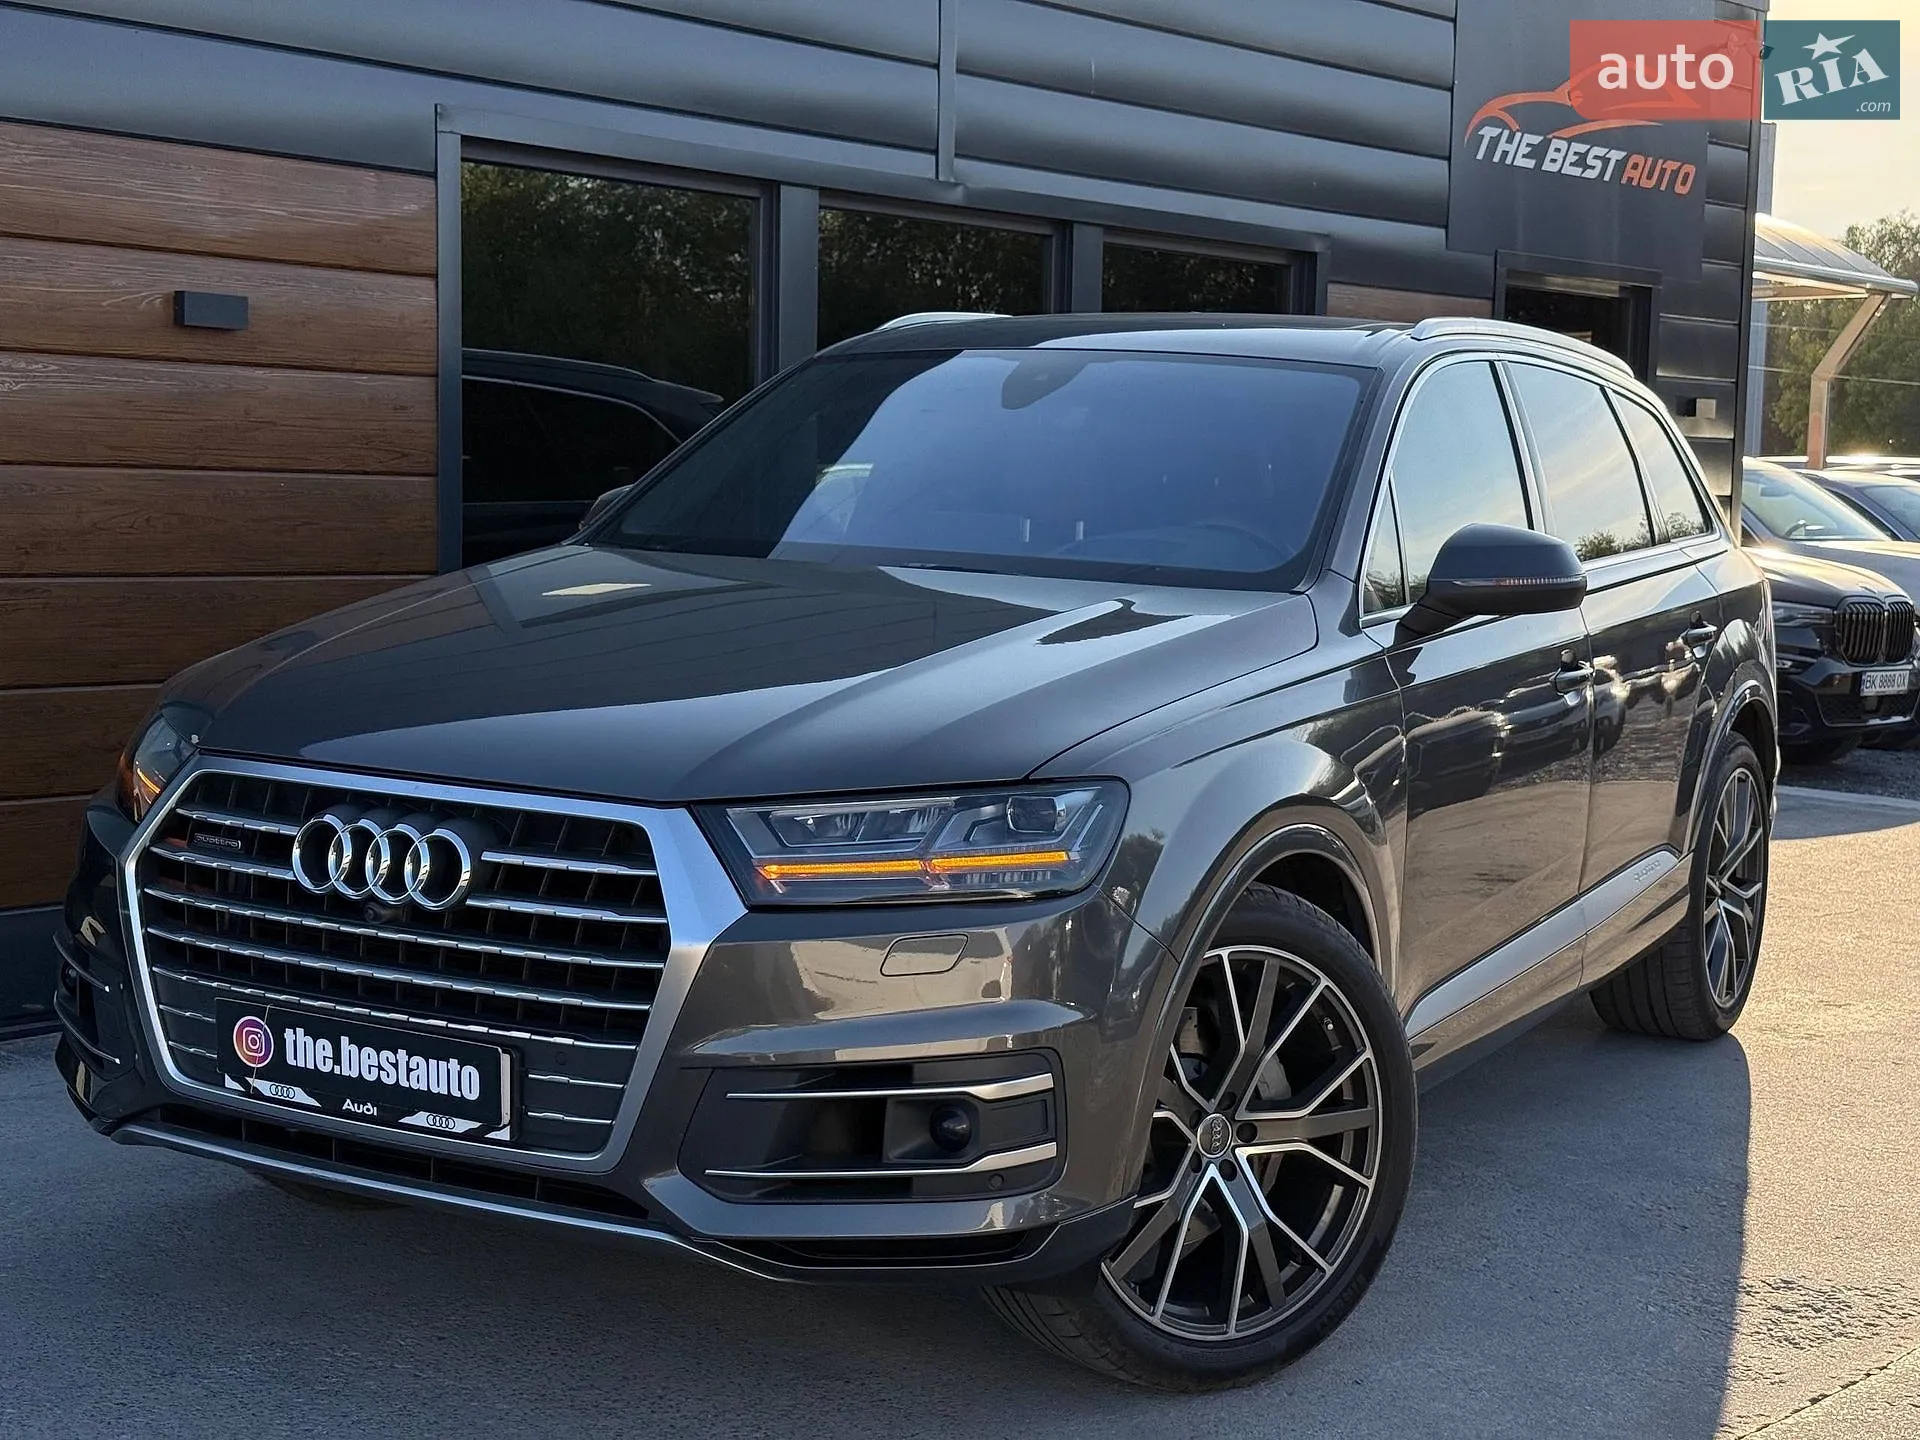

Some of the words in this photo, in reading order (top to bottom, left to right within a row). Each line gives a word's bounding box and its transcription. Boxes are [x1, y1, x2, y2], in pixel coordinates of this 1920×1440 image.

[1475, 126, 1544, 169] THE
[1541, 139, 1627, 182] BEST
[1620, 154, 1696, 196] AUTO
[1865, 674, 1877, 689] BK
[284, 1028, 481, 1101] the.bestauto
[341, 1098, 378, 1116] Audi
